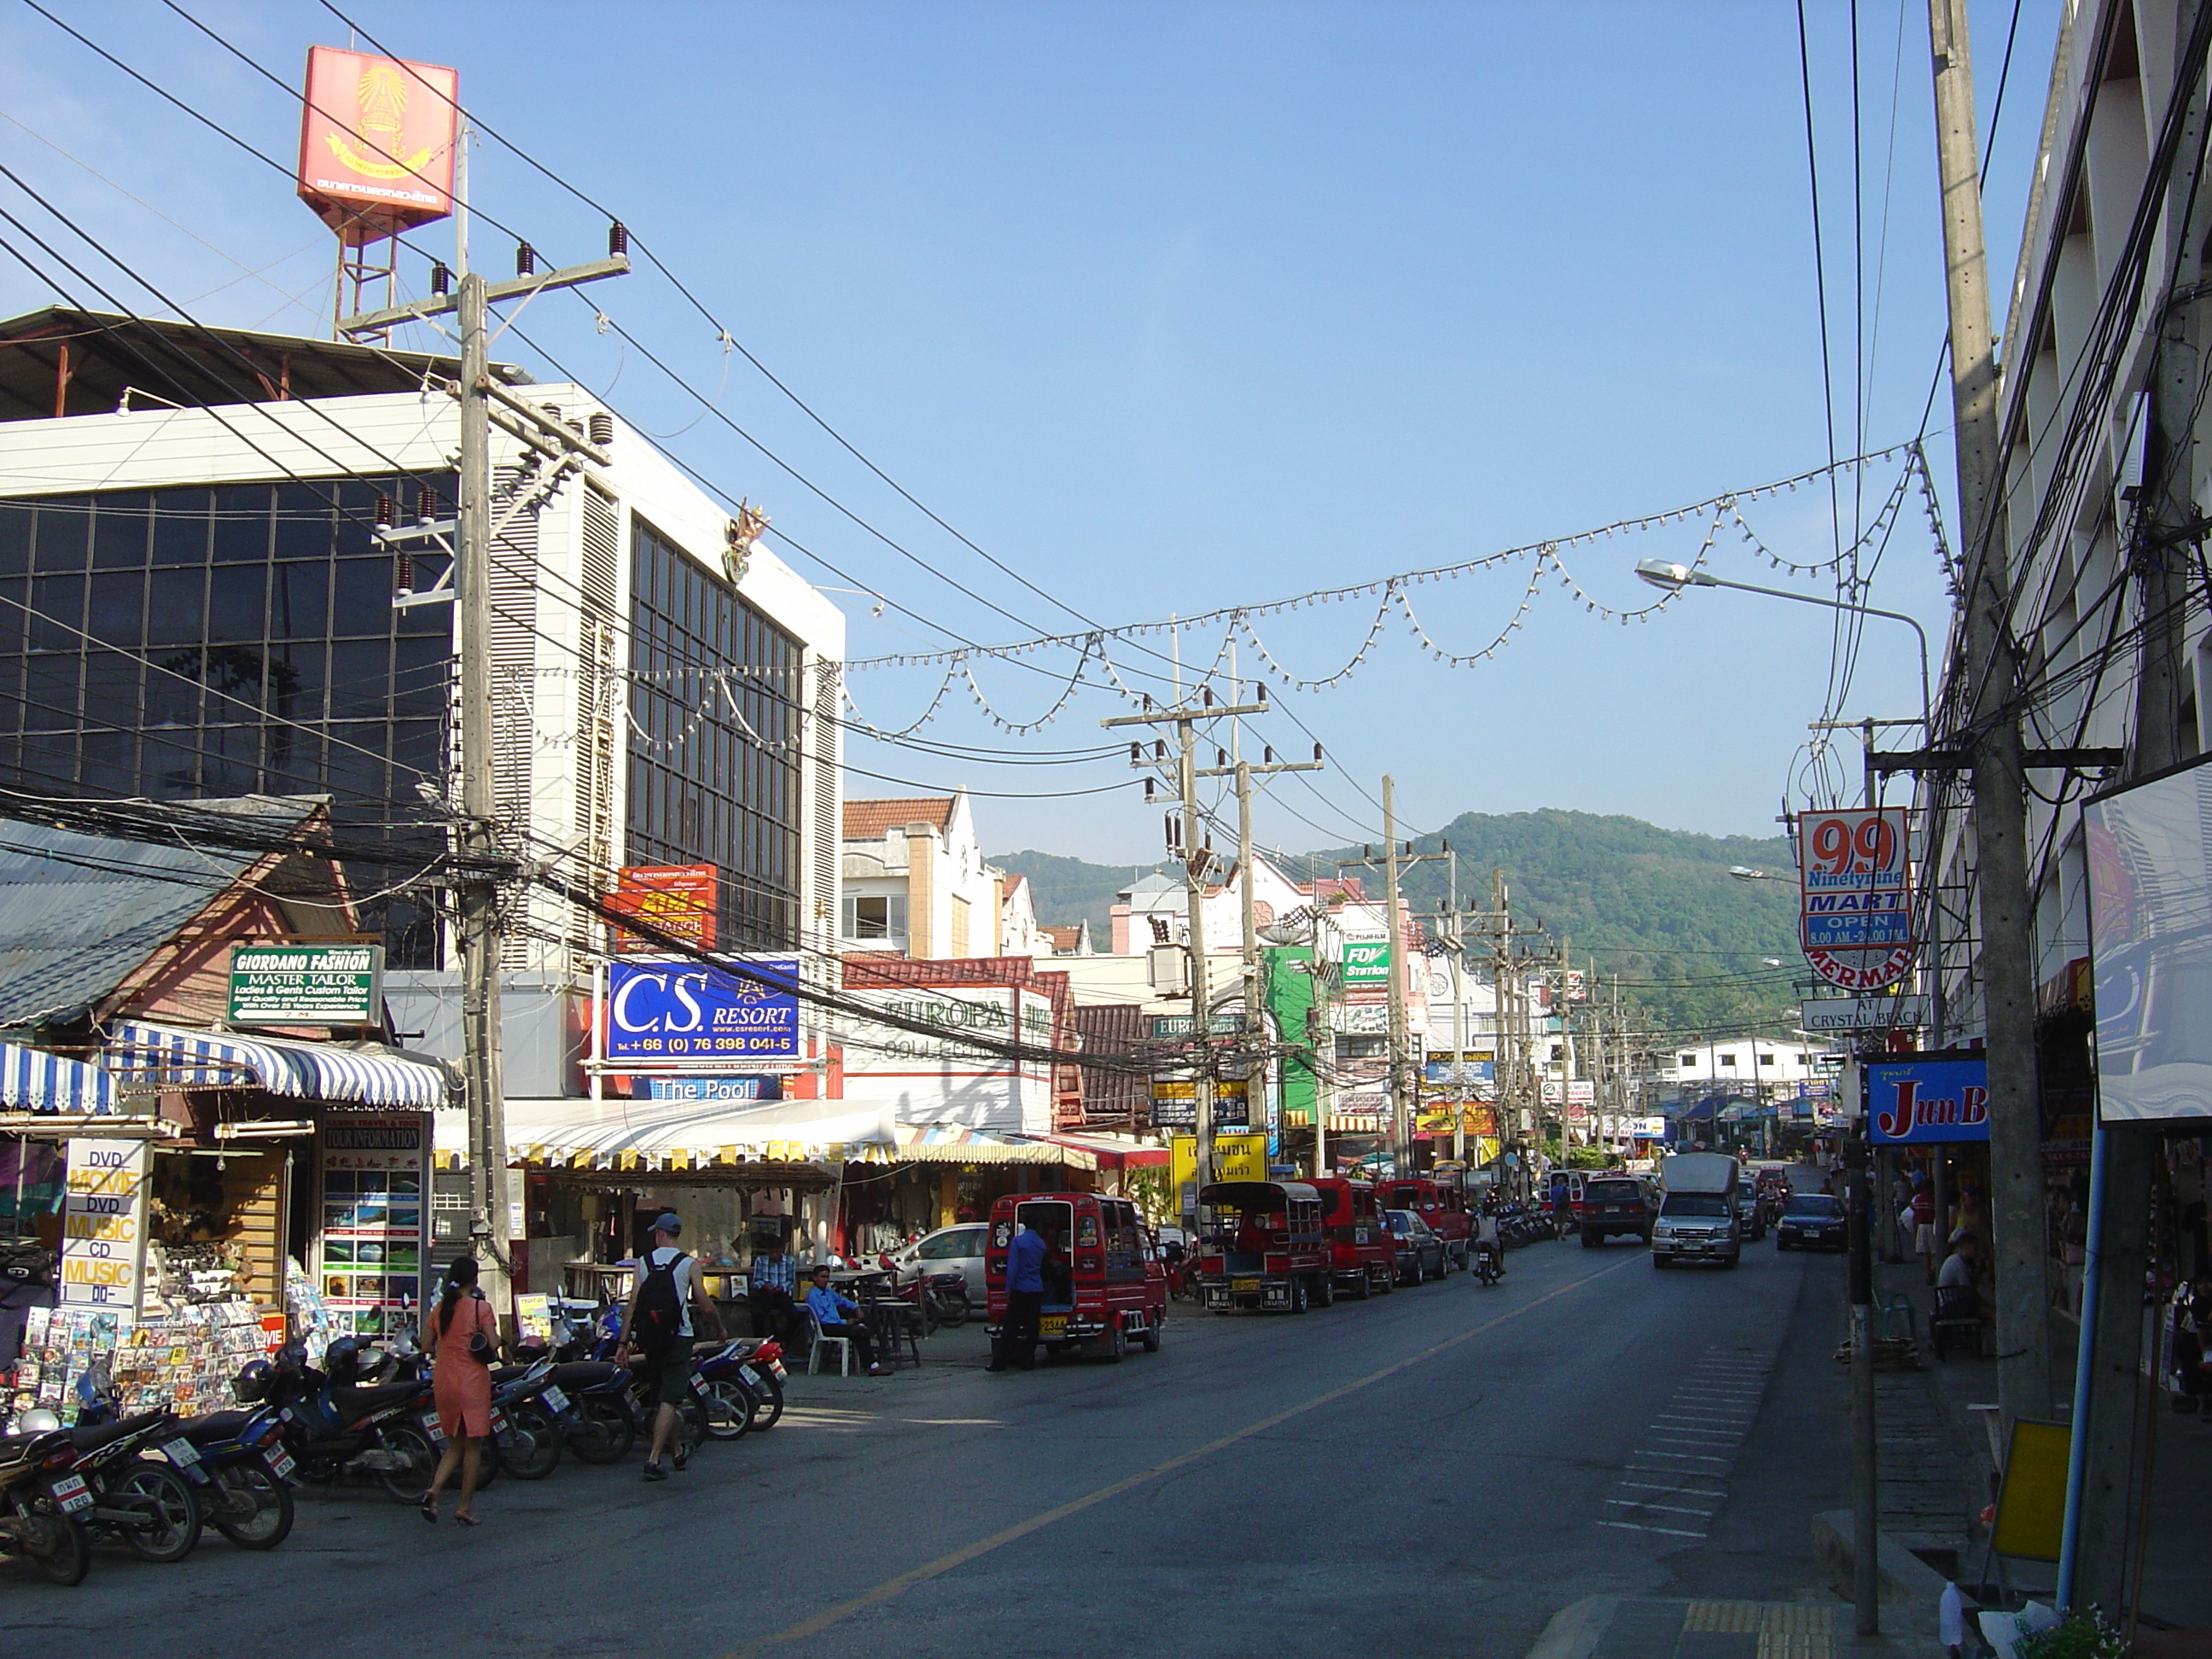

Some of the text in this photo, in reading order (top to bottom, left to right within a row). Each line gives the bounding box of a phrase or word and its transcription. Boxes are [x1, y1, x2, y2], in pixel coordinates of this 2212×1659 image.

[1812, 817, 1897, 875] 99
[1807, 869, 1902, 889] Ninetynine
[1809, 893, 1904, 912] MART
[1827, 914, 1889, 928] OPEN
[236, 953, 370, 971] GIORDANO FASHION
[248, 974, 357, 986] MASTER TAILOR
[235, 986, 368, 995] Ladies & Gents Custom Tailor
[614, 973, 707, 1033] C.S.
[1858, 998, 1874, 1010] AT
[713, 1007, 792, 1025] RESORT
[882, 1000, 1009, 1027] EUROPA
[1811, 1010, 1922, 1027] CRYSTAL BEACH
[668, 1038, 689, 1053] (0)
[694, 1038, 712, 1051] 76
[715, 1037, 745, 1051] 398
[749, 1037, 791, 1051] 041-5
[656, 1080, 749, 1099] The Pool
[328, 1129, 418, 1148] TOUR INFORMATION
[90, 1150, 122, 1167] DVD
[68, 1168, 140, 1196] MOVIE
[86, 1196, 119, 1213] DVD
[67, 1214, 136, 1241] MUSIC
[89, 1242, 111, 1259] CD
[65, 1260, 132, 1285] MUSIC
